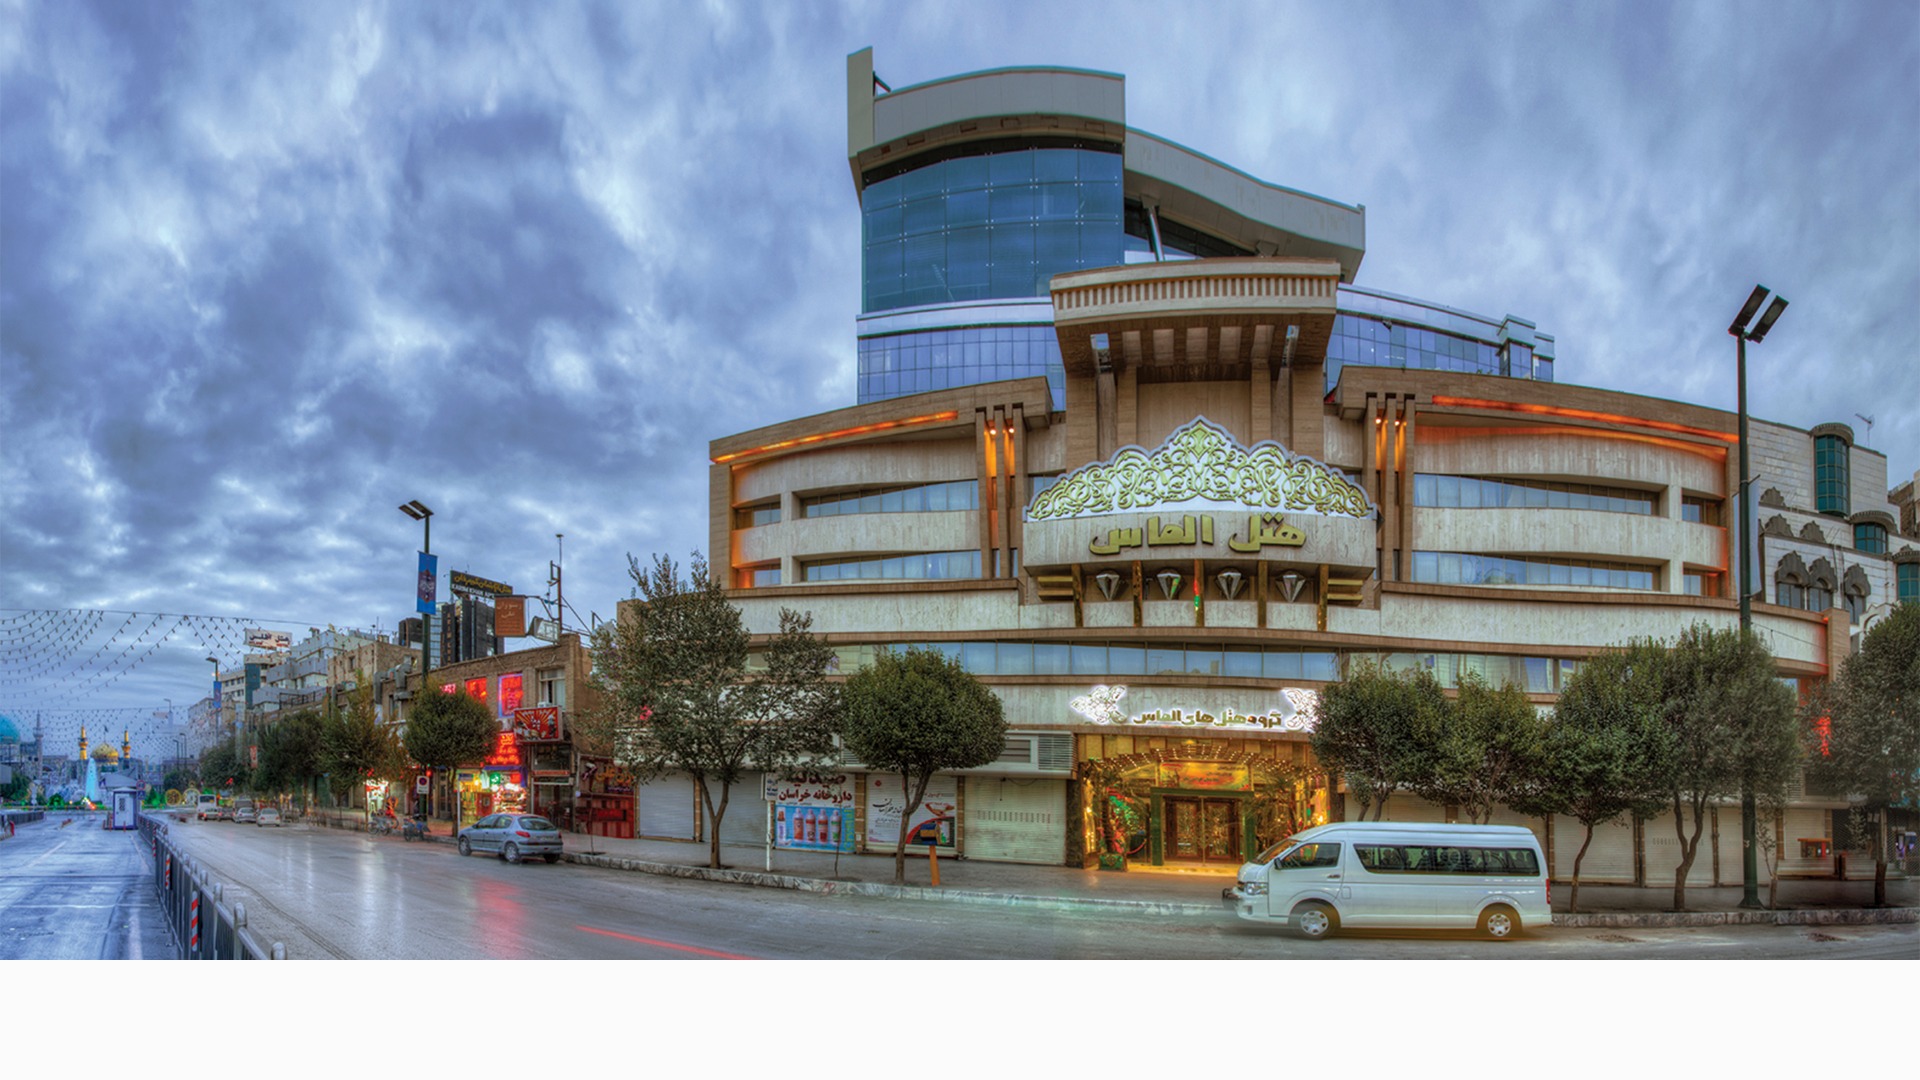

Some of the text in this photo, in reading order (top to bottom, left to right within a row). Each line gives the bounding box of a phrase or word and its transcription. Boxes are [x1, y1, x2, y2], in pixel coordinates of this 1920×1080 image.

[1089, 512, 1307, 555] هتل الماس
[1133, 709, 1282, 728] گروه هتل های الماس
[778, 788, 853, 804] داروخانه خراسان
